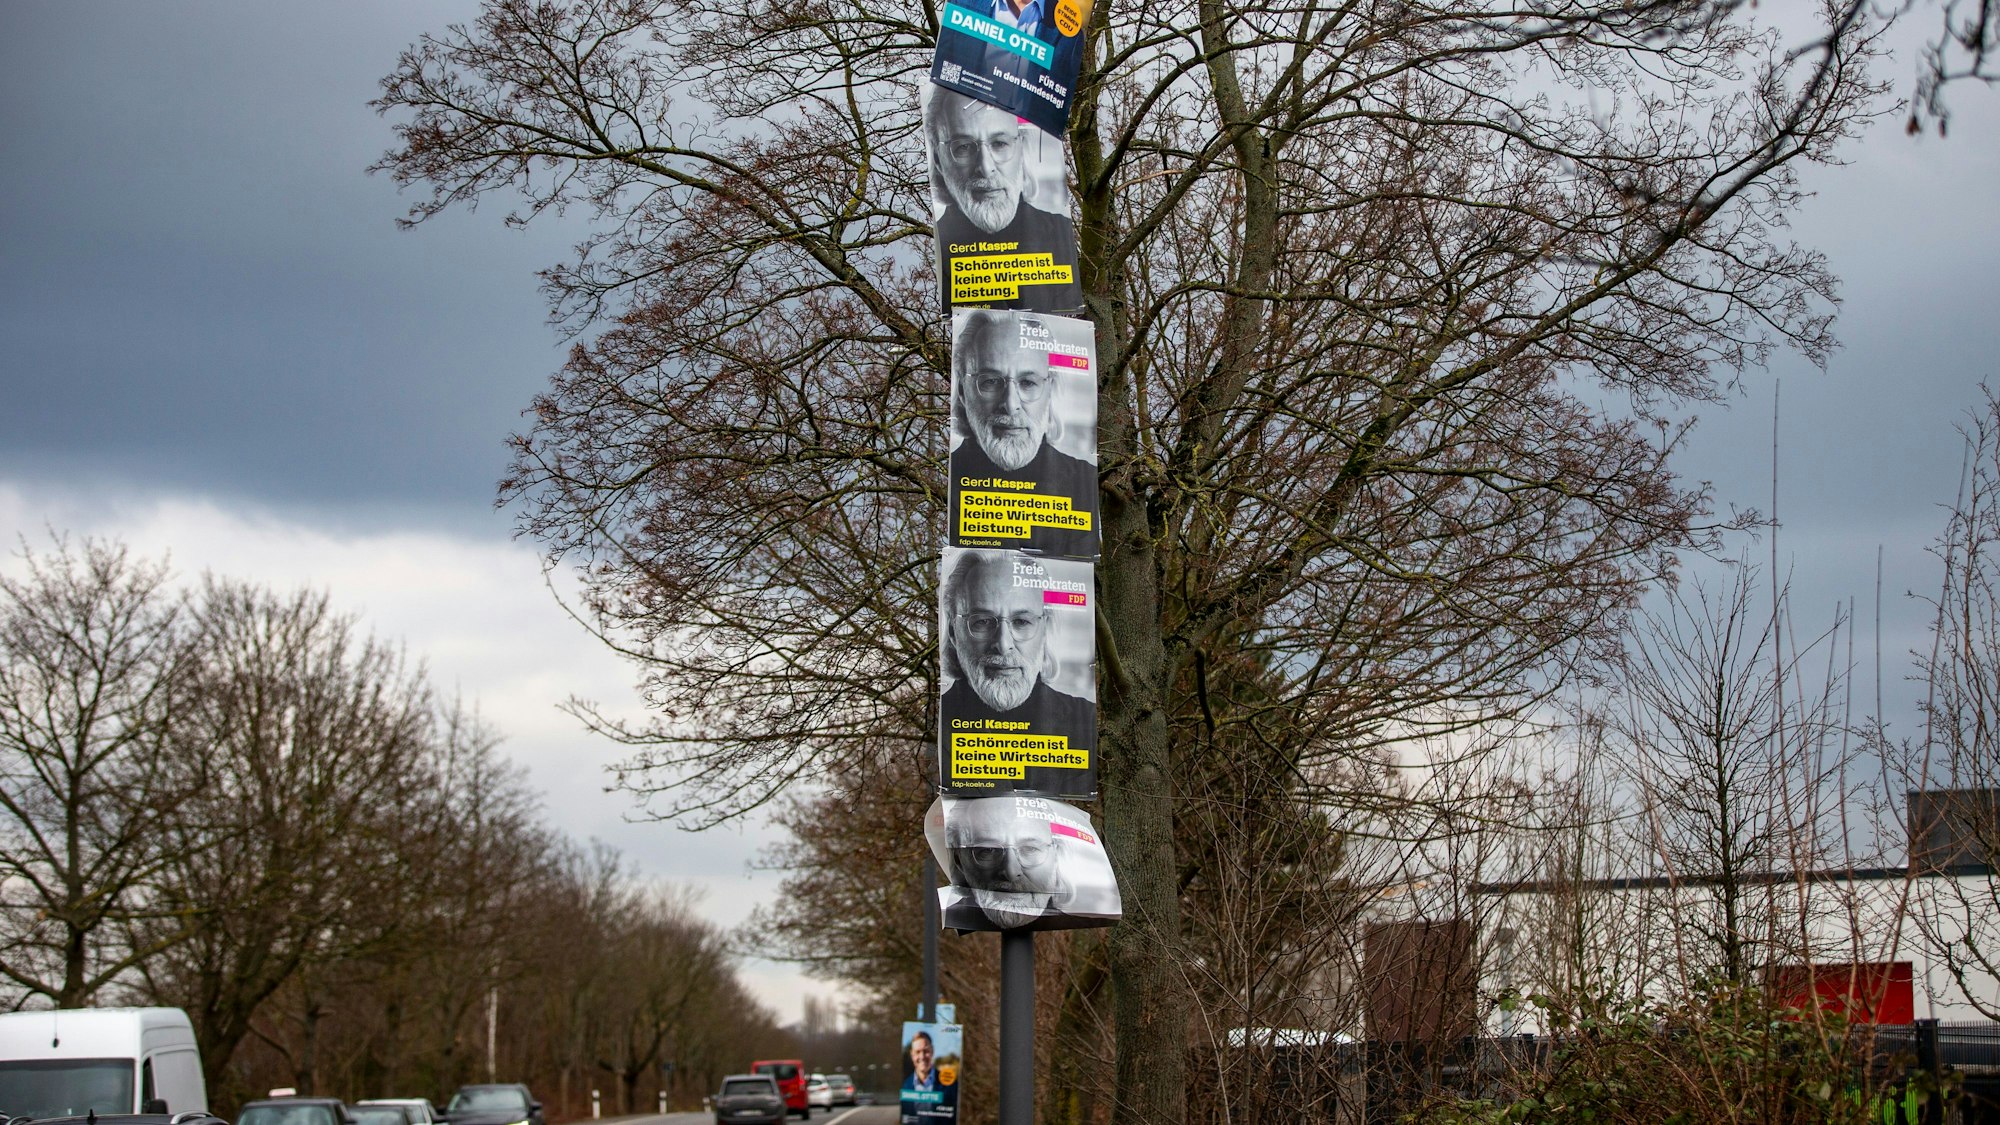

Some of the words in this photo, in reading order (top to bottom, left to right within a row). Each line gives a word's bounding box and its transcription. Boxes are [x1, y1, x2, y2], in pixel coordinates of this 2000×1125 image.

[1058, 8, 1079, 27] STIMMEN
[1064, 4, 1077, 17] BEIDE
[1060, 19, 1073, 31] CDU
[951, 10, 1006, 43] DANIEL
[1009, 33, 1047, 61] OTTE
[993, 66, 1002, 78] in
[1003, 71, 1020, 86] den
[1020, 78, 1065, 109] Bundestag!
[1038, 74, 1055, 90] FÜR
[1054, 84, 1067, 97] SIE
[949, 243, 977, 254] Gerd
[979, 242, 1019, 252] Kaspar
[954, 257, 1034, 272] Schönreden
[1035, 257, 1051, 267] ist
[955, 274, 991, 285] keine
[994, 270, 1070, 283] Wirtschafts-
[955, 286, 1015, 298] leistung.
[1019, 323, 1049, 338] Freie
[1019, 336, 1088, 356] Demokraten
[1072, 358, 1088, 368] FDP
[960, 476, 991, 488] Gerd
[993, 478, 1036, 490] Kaspar
[964, 495, 1050, 509] Schönreden
[1052, 499, 1068, 511] ist
[963, 508, 1003, 520] keine
[1006, 510, 1088, 526] Wirtschafts-
[963, 522, 1027, 536] leistung.
[959, 539, 1001, 547] fdp-koeln.de
[1013, 562, 1044, 575] Freie
[1013, 575, 1086, 592] Demokraten
[1068, 594, 1085, 604] FDP
[951, 718, 982, 729] Gerd
[985, 719, 1030, 731] Kaspar
[955, 737, 1045, 749] Schönreden
[1047, 739, 1064, 750] ist
[955, 750, 996, 761] keine
[999, 751, 1085, 764] Wirtschafts-
[955, 763, 1021, 777] leistung.
[951, 781, 995, 789] fdp-koeln.de
[1015, 797, 1048, 810] Freie
[1015, 806, 1091, 834] Demokraten
[1077, 831, 1092, 842] FDP
